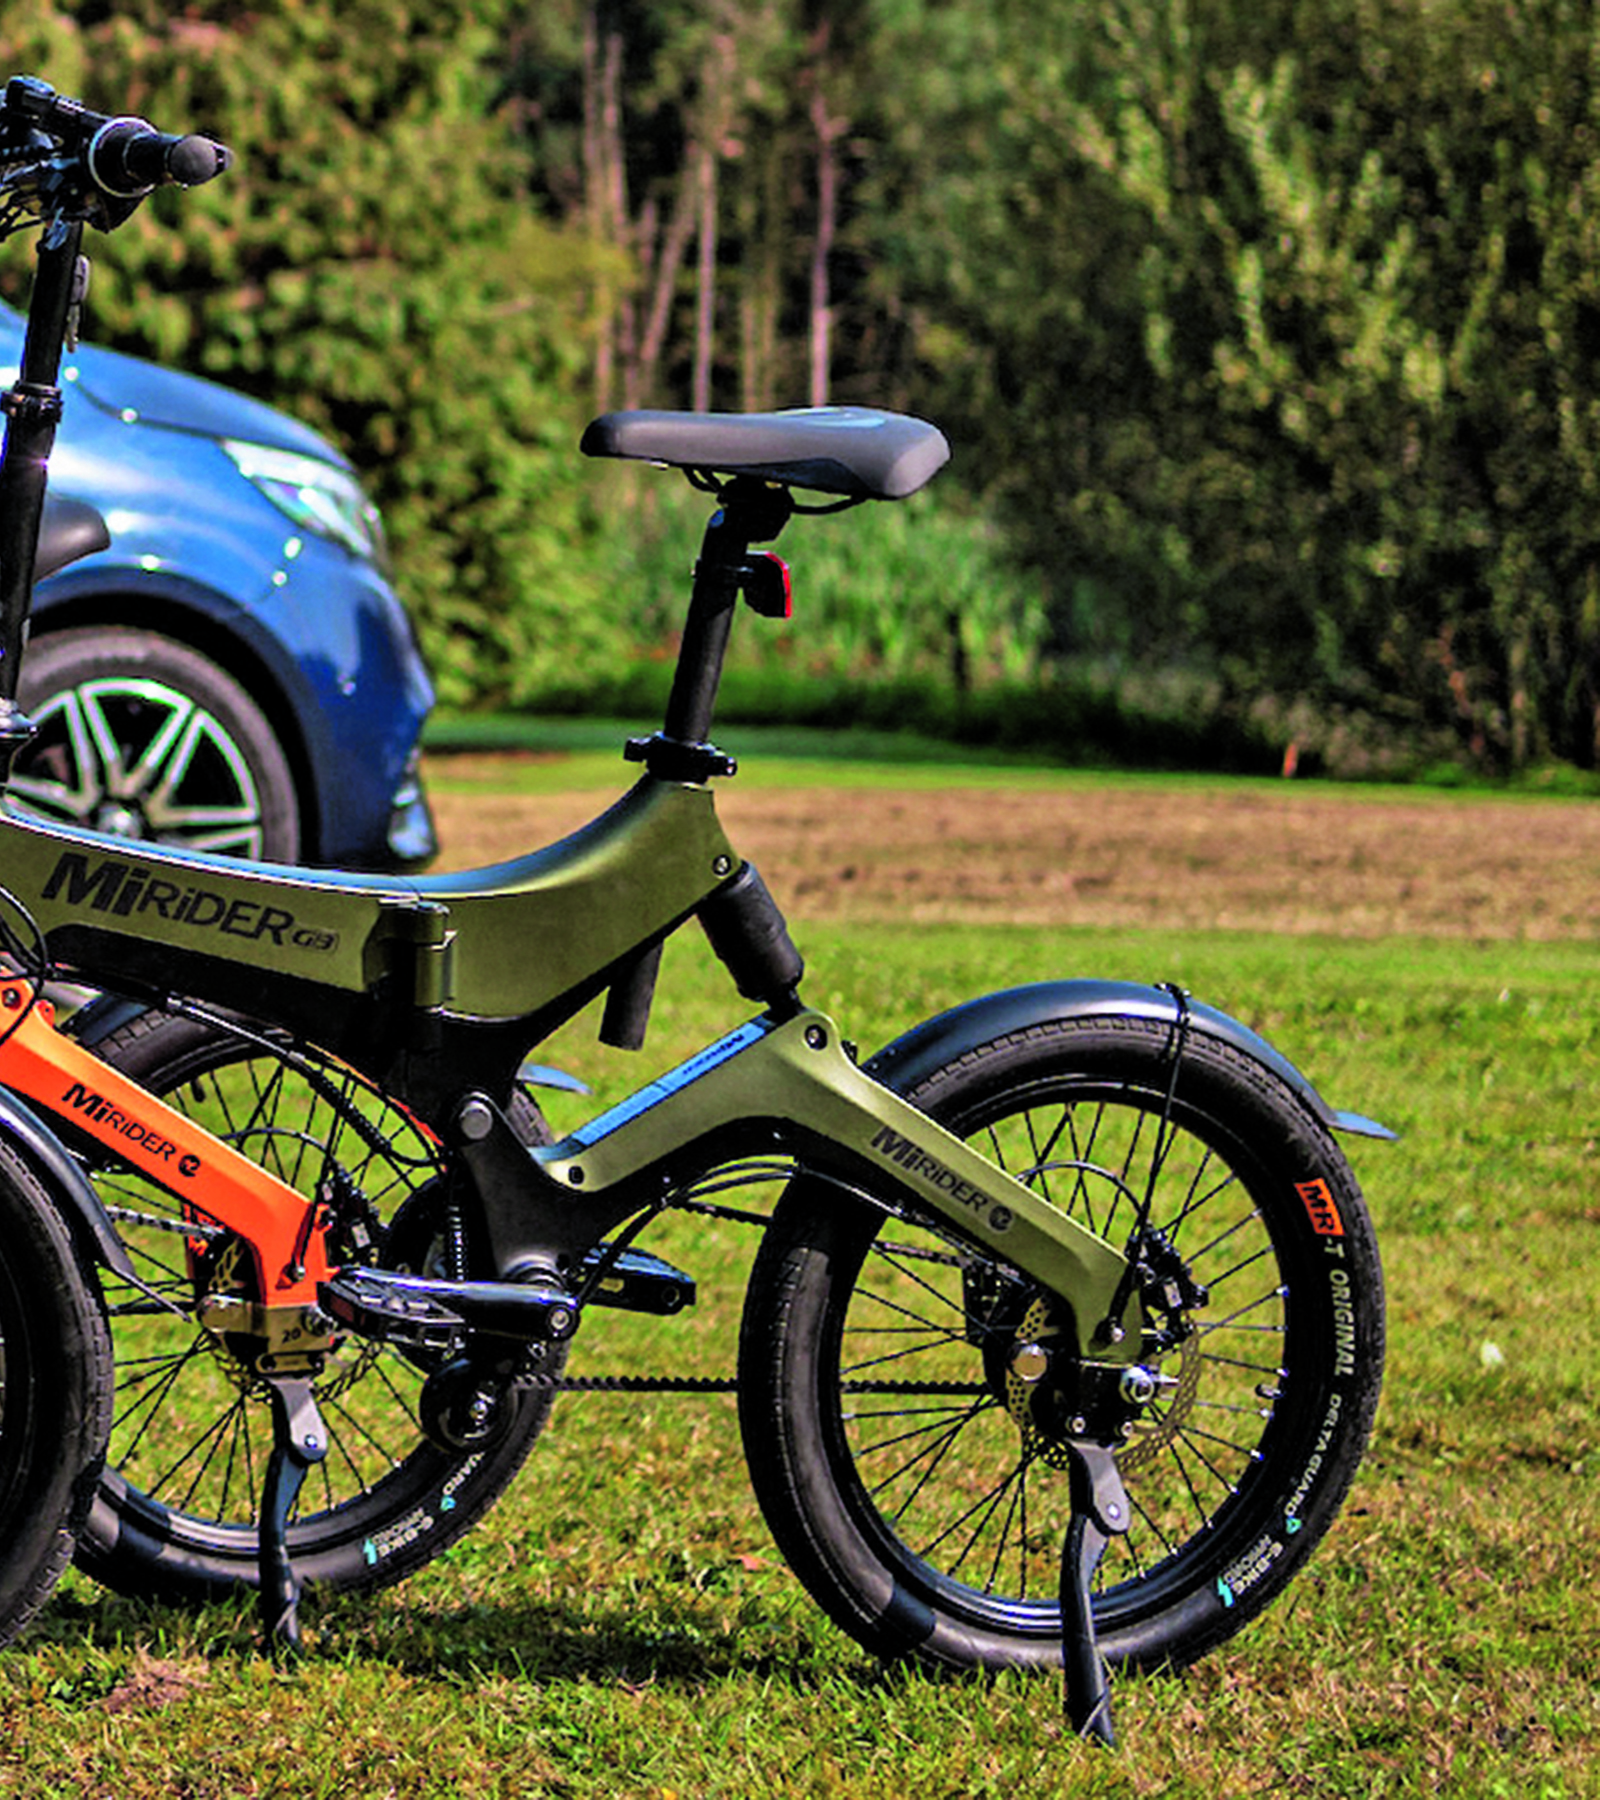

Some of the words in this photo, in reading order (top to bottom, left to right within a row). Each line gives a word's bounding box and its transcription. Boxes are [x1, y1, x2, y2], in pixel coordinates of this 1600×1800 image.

[1329, 1269, 1355, 1376] ORIGINAL
[1315, 1393, 1342, 1451] DELTA
[442, 1452, 485, 1495] UARD
[1284, 1454, 1322, 1517] GUARD
